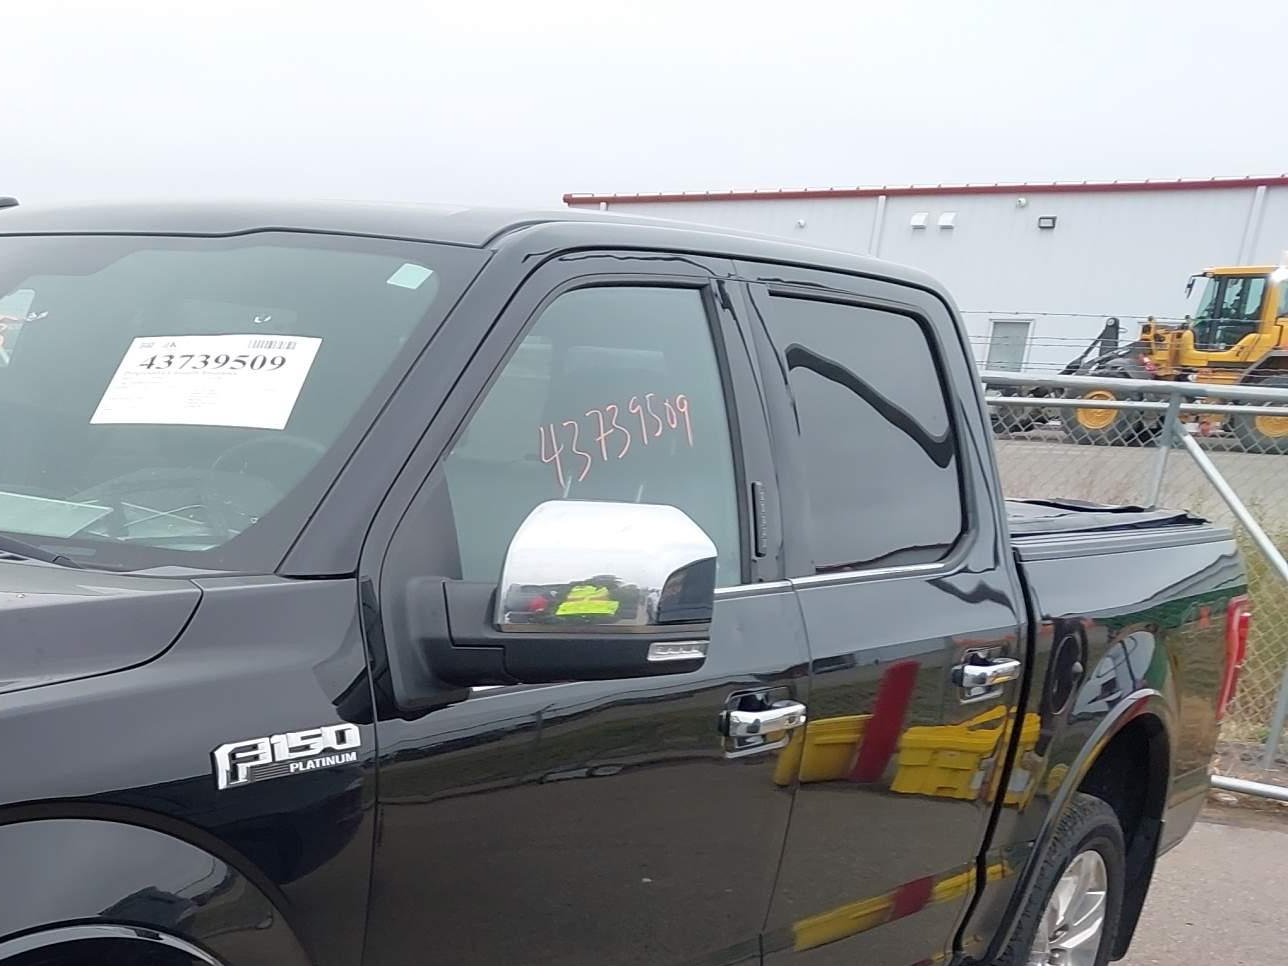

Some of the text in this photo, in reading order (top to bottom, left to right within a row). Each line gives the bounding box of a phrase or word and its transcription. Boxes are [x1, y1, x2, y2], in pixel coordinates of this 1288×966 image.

[139, 353, 287, 372] 43739509
[538, 393, 694, 489] 43739509
[289, 751, 358, 773] PLATINUM
